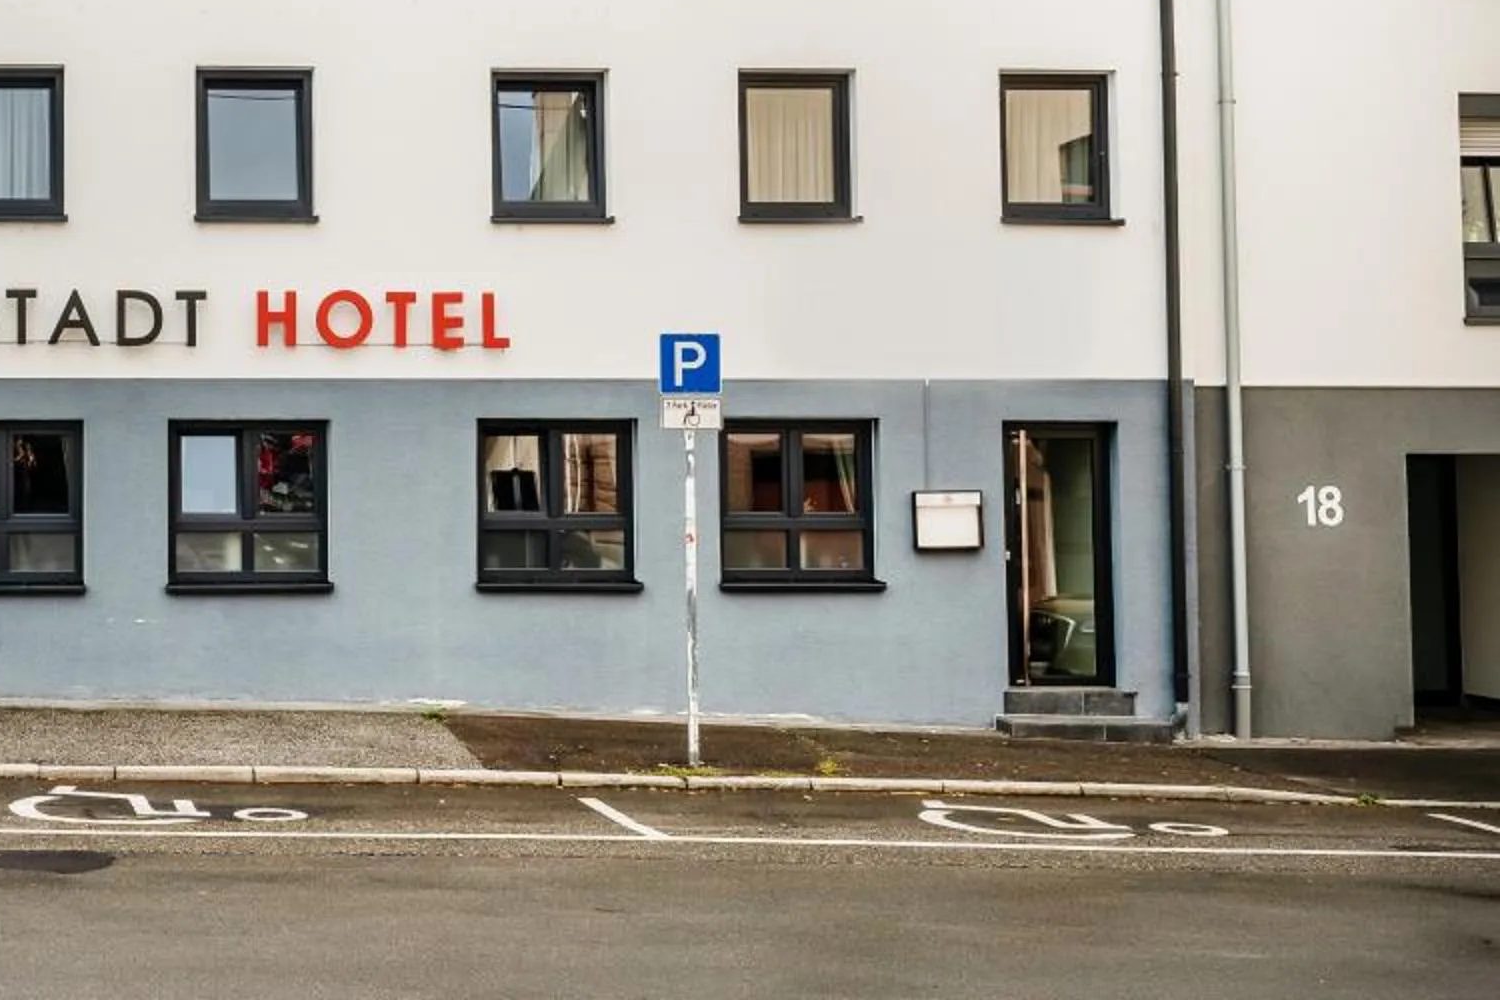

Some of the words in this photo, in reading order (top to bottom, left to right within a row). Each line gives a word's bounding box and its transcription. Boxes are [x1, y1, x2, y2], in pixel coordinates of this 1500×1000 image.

[256, 288, 511, 350] HOTEL
[674, 341, 707, 387] P
[1297, 485, 1344, 527] 18
